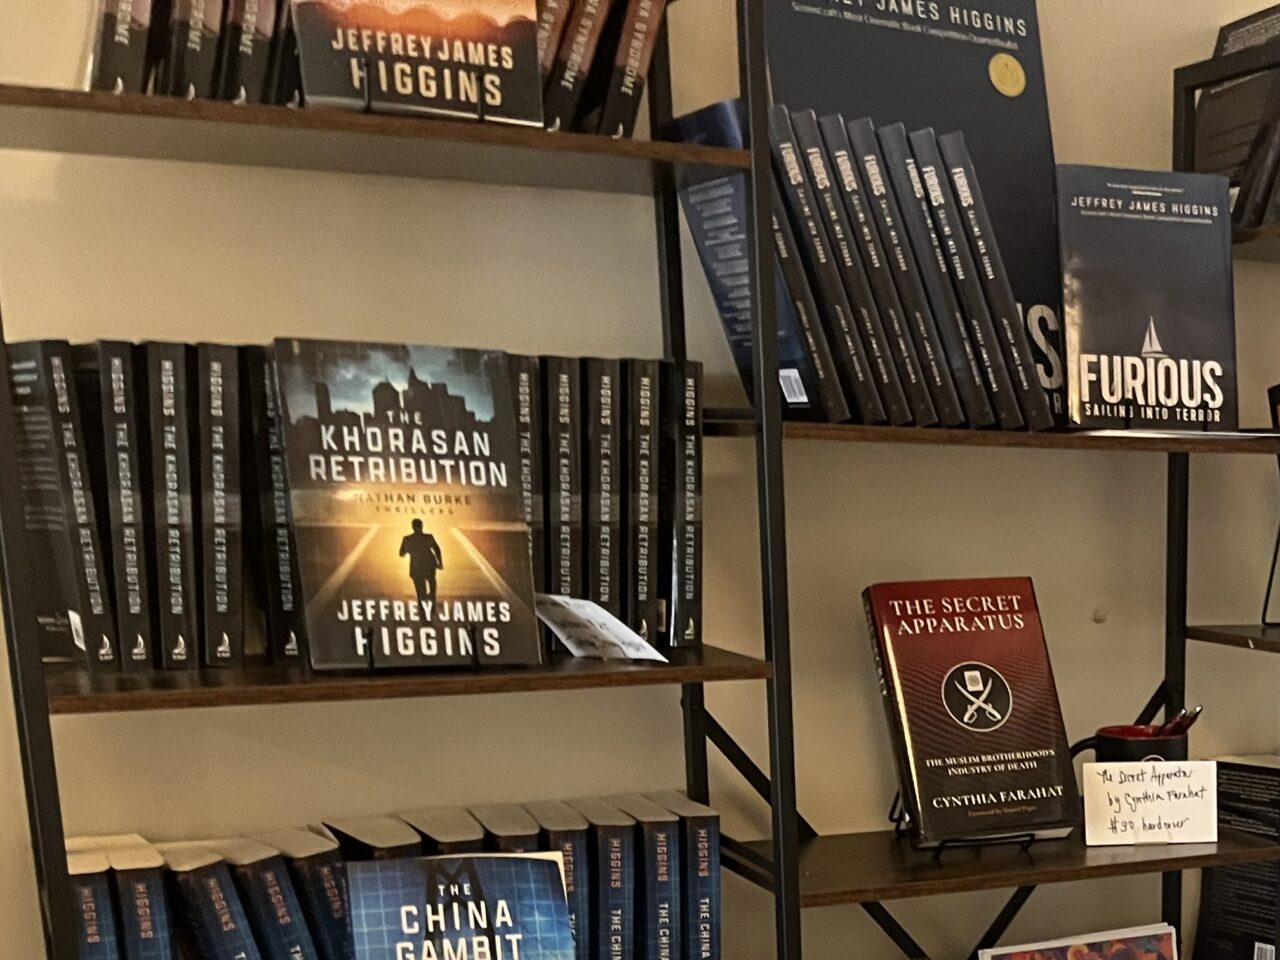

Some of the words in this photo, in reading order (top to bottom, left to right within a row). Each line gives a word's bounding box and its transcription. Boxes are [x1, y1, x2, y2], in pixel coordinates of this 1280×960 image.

[876, 0, 940, 21] JAMES
[950, 7, 1028, 37] HIGGINS
[332, 28, 431, 59] JEFFREY
[437, 41, 514, 70] JAMES
[351, 58, 503, 107] HIGGINS
[1071, 197, 1123, 210] JEFFREY
[1129, 201, 1166, 214] JAMES
[1171, 204, 1219, 217] HIGGINS
[1079, 354, 1224, 409] FURIOUS
[387, 410, 422, 425] THE
[1141, 405, 1169, 421] INTO
[321, 425, 490, 456] KHORASAN
[309, 454, 508, 488] RETRIBUTION
[337, 600, 434, 622] JEFFREY
[439, 601, 511, 622] JAMES
[889, 599, 934, 617] THE
[941, 595, 1021, 615] SECRET
[898, 613, 1024, 636] APPARATUS
[925, 758, 943, 768] THE
[945, 755, 979, 767] MUSLIM
[948, 765, 992, 776] INDUSTRY
[994, 763, 1005, 773] OF
[1008, 761, 1038, 772] DEATH
[932, 793, 997, 809] CYNTHIA
[999, 785, 1064, 803] FARAHAT
[1107, 792, 1121, 813] by
[697, 829, 709, 878] HIGGINS
[438, 883, 471, 897] THE
[400, 899, 514, 935] CHINA
[700, 897, 710, 919] THE
[700, 924, 710, 958] CHINA
